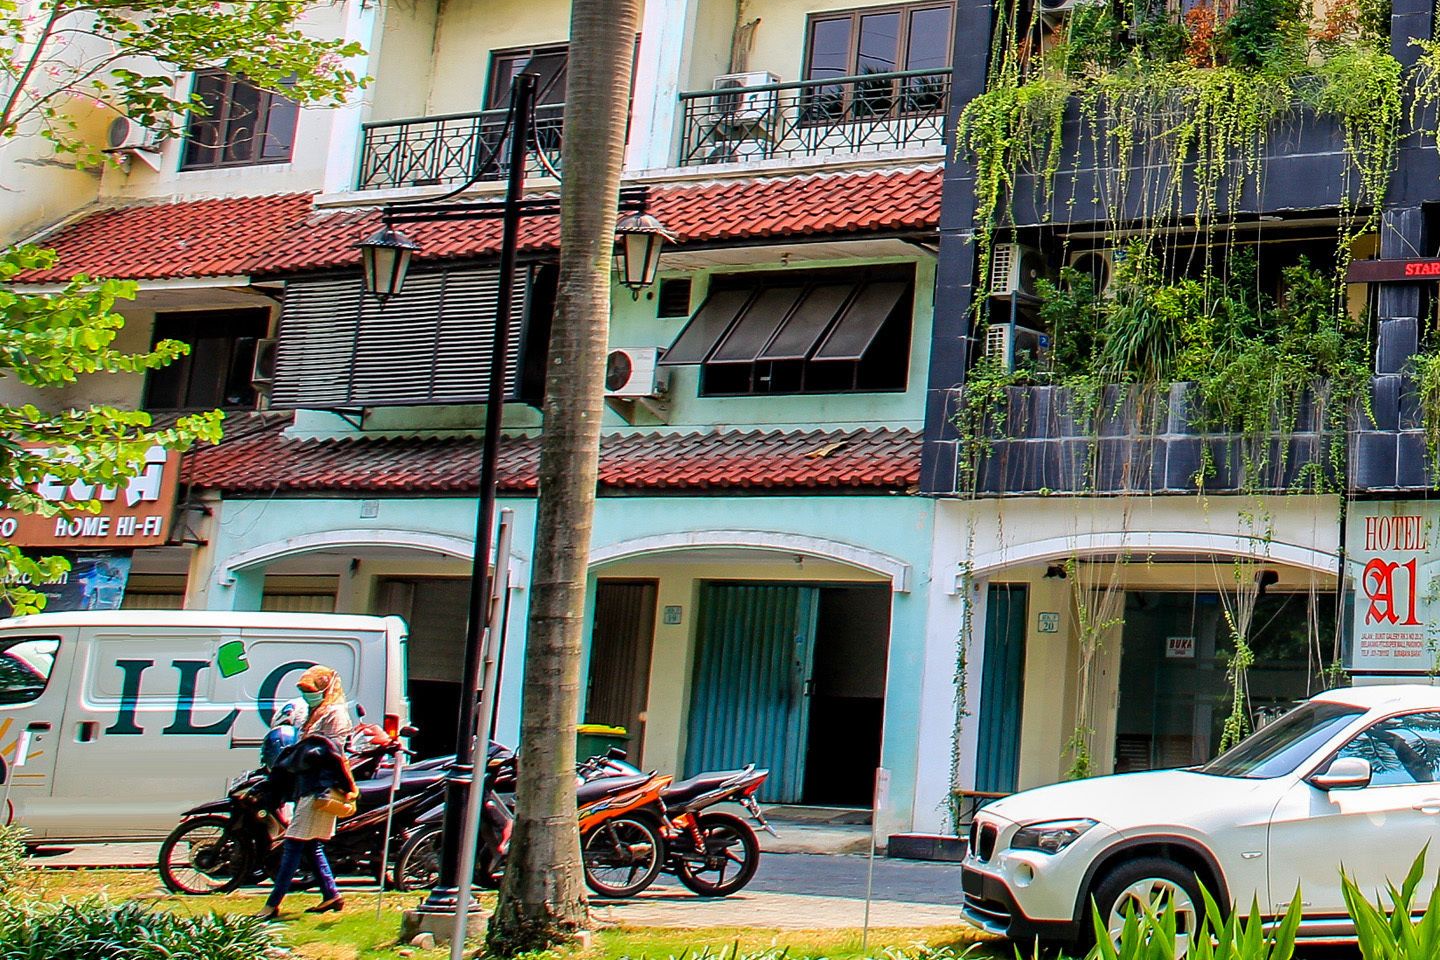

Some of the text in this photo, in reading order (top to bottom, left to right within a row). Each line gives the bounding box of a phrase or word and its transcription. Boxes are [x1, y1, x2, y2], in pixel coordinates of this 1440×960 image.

[54, 516, 111, 537] HOME
[115, 516, 163, 537] HI-FI
[1364, 515, 1426, 551] HOTEL
[1362, 557, 1424, 626] A1
[1169, 639, 1192, 649] BUKA
